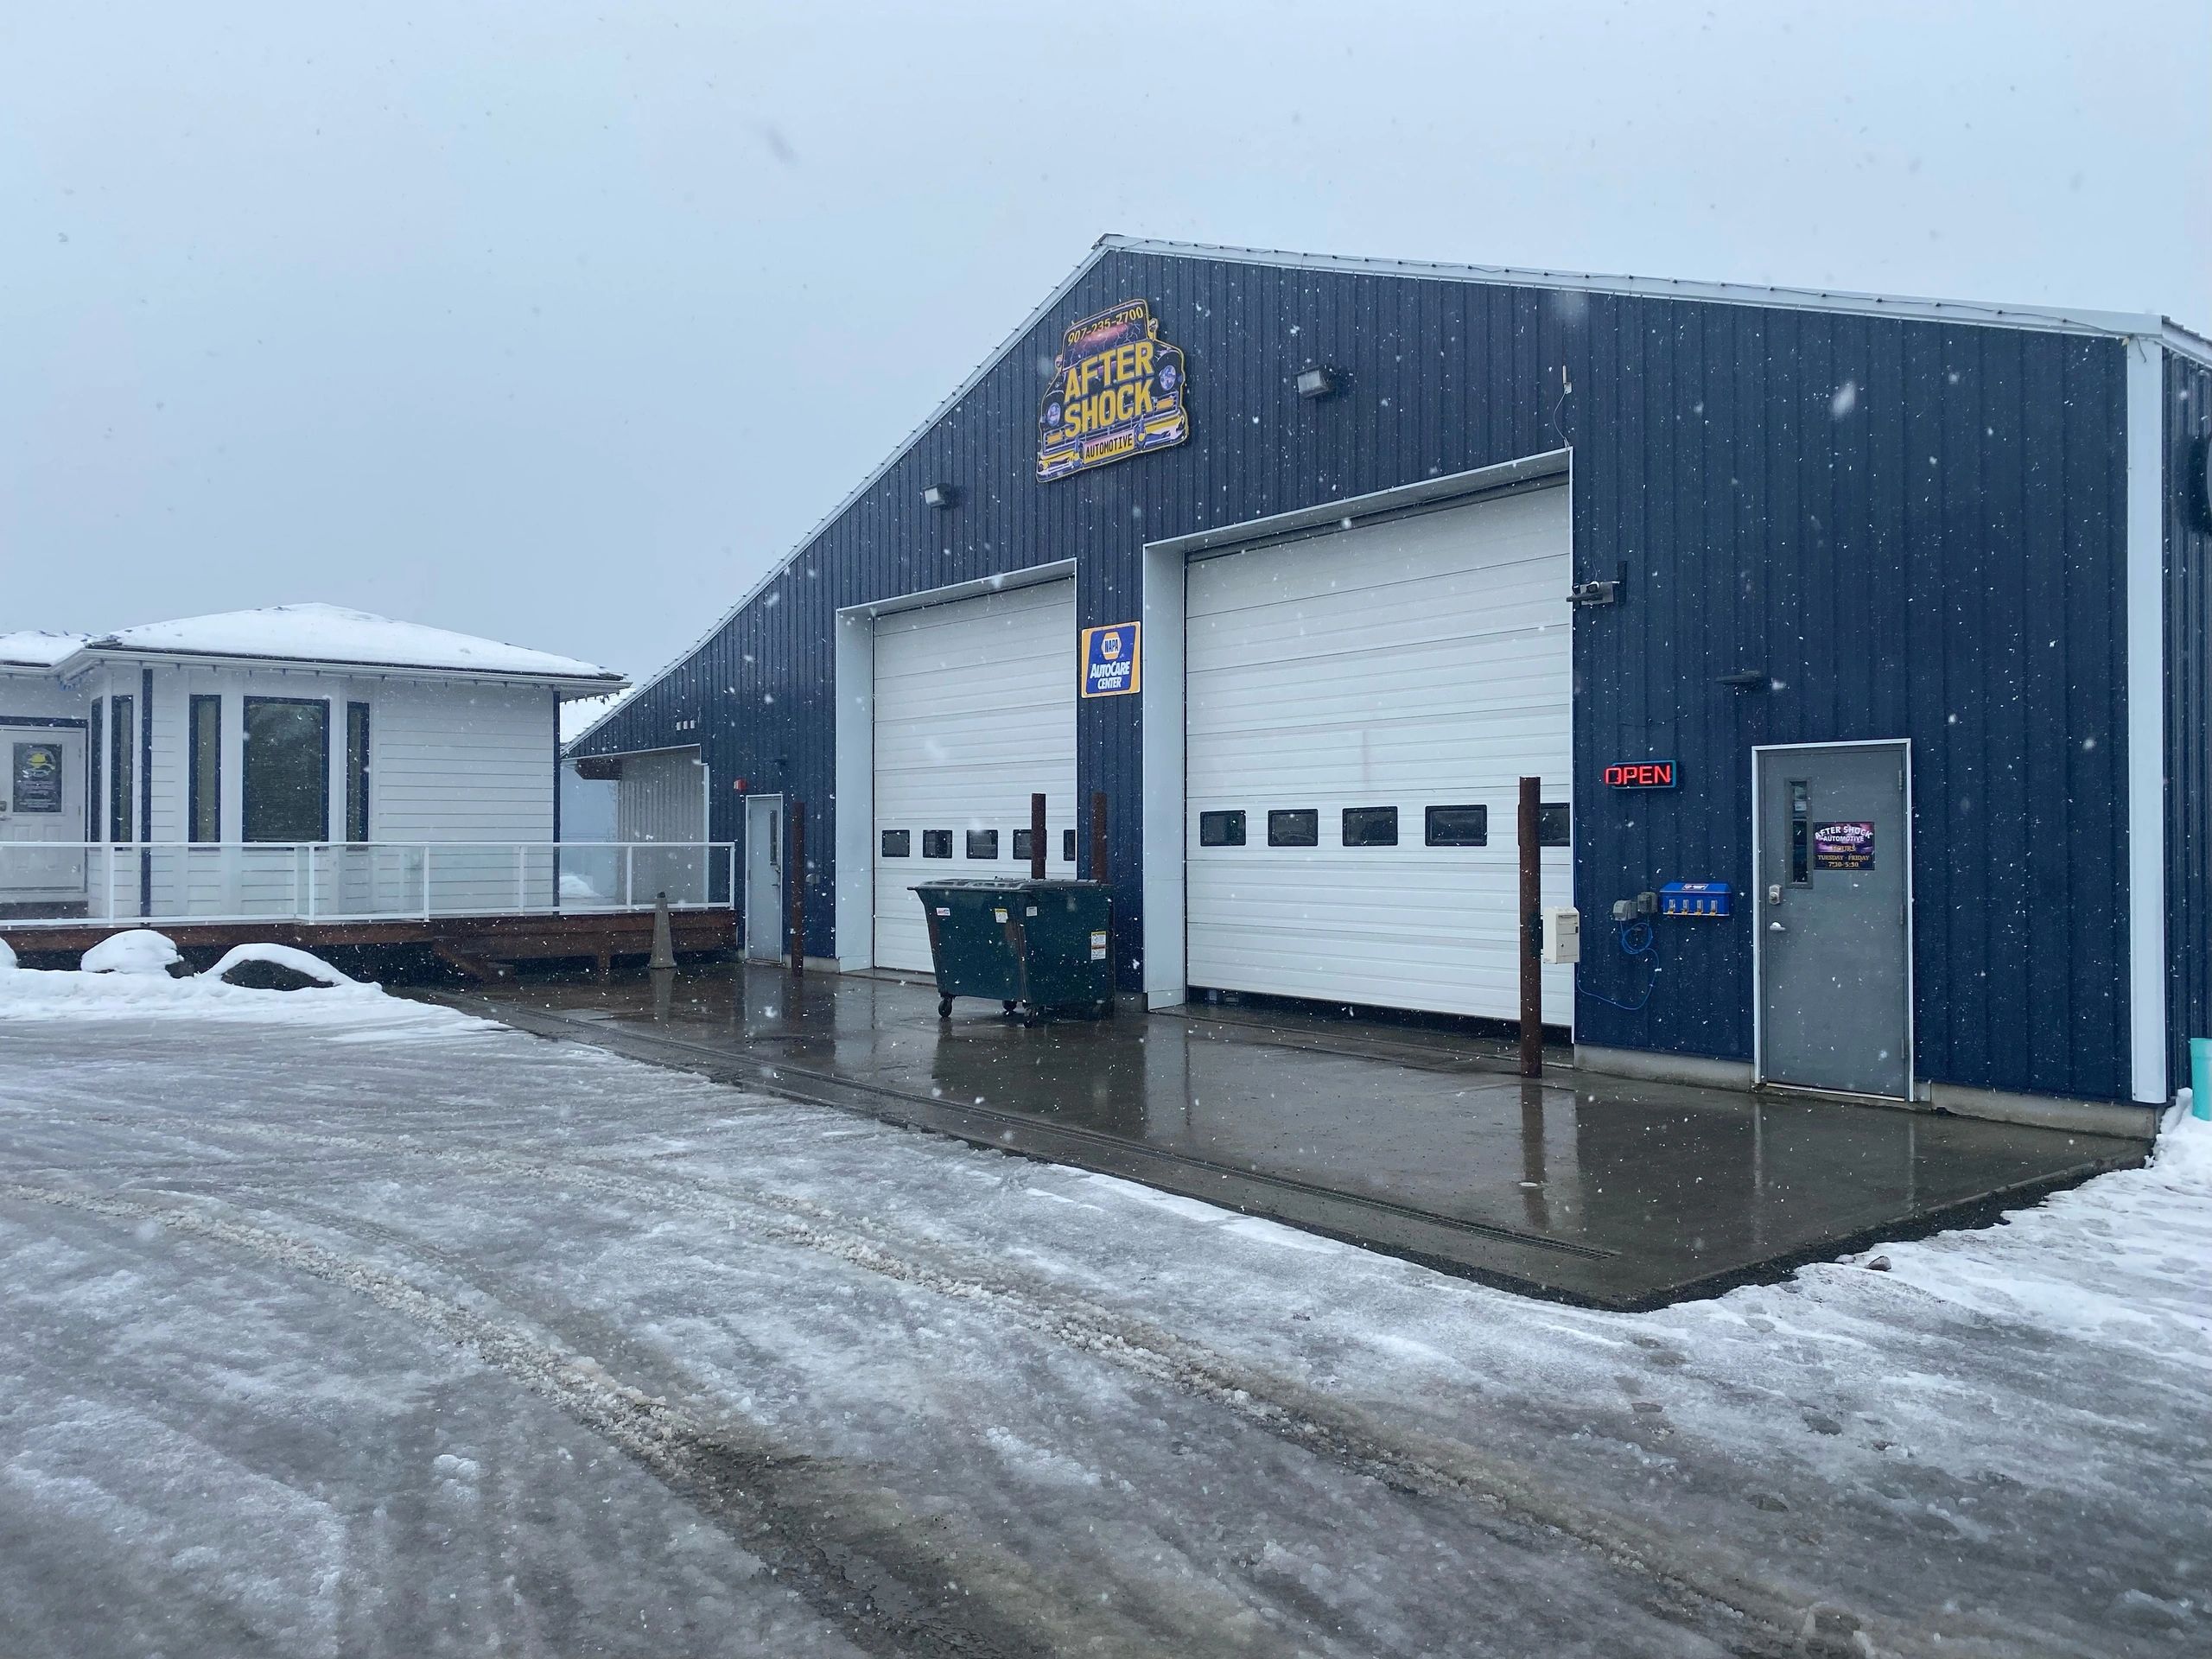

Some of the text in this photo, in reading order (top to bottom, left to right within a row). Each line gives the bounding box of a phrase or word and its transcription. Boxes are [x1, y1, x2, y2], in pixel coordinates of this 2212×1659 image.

[1068, 307, 1144, 346] 907-235-2700
[1065, 341, 1154, 403] AFTER
[1065, 378, 1154, 438] SHOCK
[1085, 435, 1133, 458] AUTOMOTIVE
[1104, 639, 1119, 653] NAPA
[1097, 677, 1122, 690] CENTER
[1605, 765, 1671, 785] OPEN
[1815, 825, 1873, 839] AFTER SHOCK
